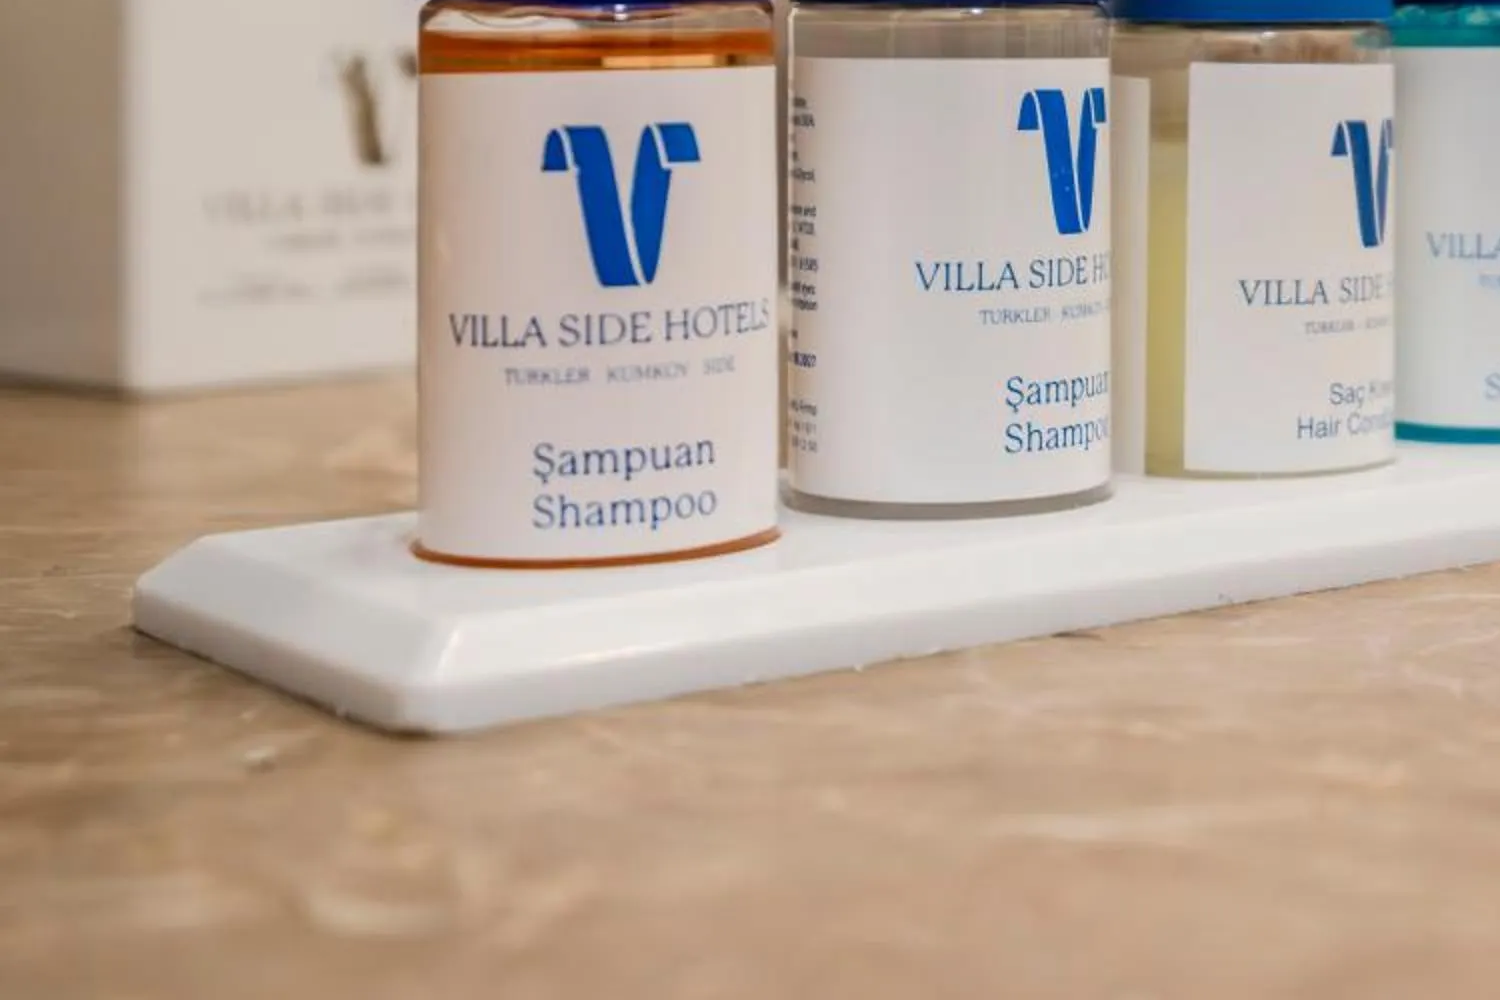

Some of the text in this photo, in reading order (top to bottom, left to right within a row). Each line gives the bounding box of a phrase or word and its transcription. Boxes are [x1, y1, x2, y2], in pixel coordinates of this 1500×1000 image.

[915, 261, 1020, 292] VILLA
[1029, 254, 1088, 289] SIDE
[1238, 279, 1329, 306] VILLA
[1338, 273, 1384, 304] SIDE
[449, 297, 770, 348] VILLA SIDE HOTELS
[1329, 382, 1366, 409] Saç
[1296, 415, 1342, 440] Hair
[532, 438, 715, 484] Şampuan
[532, 488, 718, 531] Shampoo
